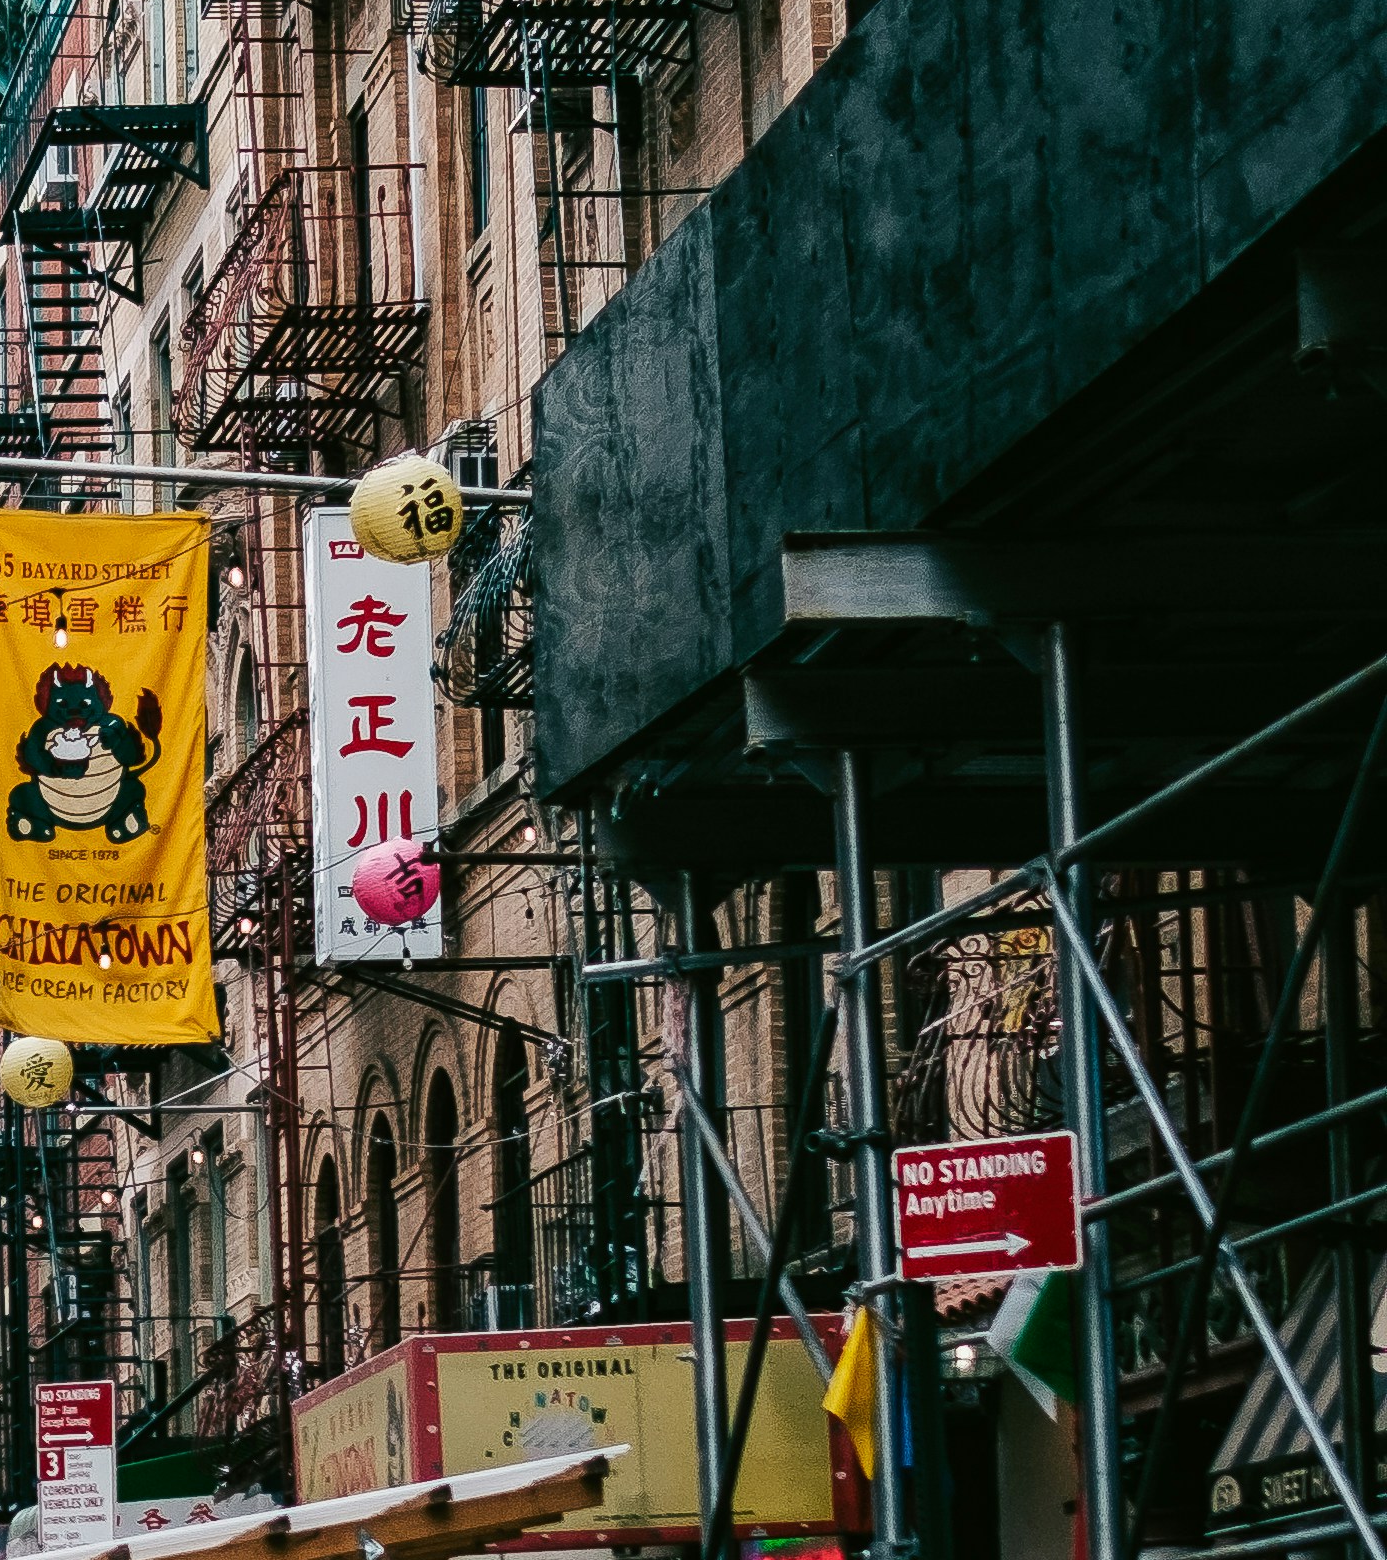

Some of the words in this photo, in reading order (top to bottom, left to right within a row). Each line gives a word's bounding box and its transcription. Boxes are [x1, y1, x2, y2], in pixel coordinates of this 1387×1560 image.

[398, 478, 457, 541] 福
[22, 561, 98, 580] BAYARD
[102, 561, 174, 581] STREET
[336, 594, 415, 849] 老正川
[48, 849, 88, 861] SINCE
[92, 849, 120, 861] 1978
[386, 852, 428, 899] 吉
[5, 877, 46, 902] THE
[56, 881, 169, 907] ORIGINAL
[2, 969, 26, 993] ICE
[30, 978, 94, 1002] CREAM
[102, 979, 190, 1005] FACTORY
[20, 1053, 54, 1090] 愛
[902, 1161, 934, 1187] NO
[938, 1150, 1047, 1184] STANDING
[905, 1188, 997, 1219] Anytime
[488, 1362, 526, 1381] THE
[536, 1359, 635, 1378] ORIGINAL
[41, 1390, 54, 1402] NO
[56, 1388, 101, 1402] STANDING
[45, 1451, 60, 1477] 3
